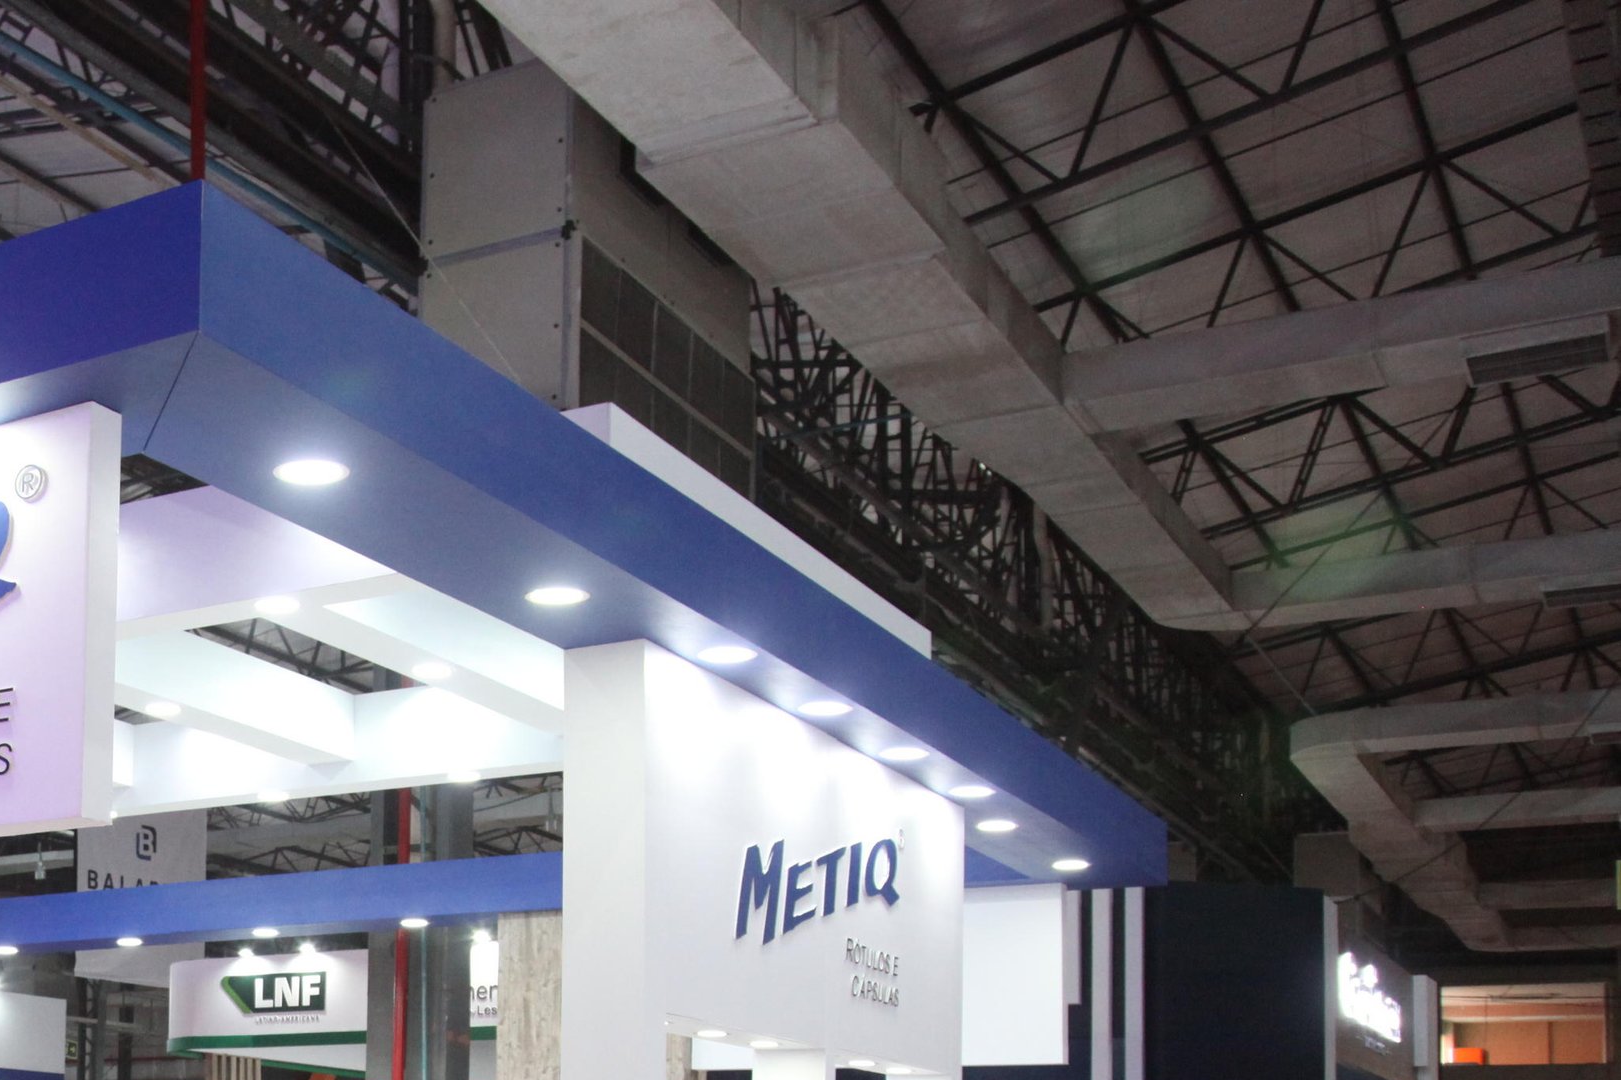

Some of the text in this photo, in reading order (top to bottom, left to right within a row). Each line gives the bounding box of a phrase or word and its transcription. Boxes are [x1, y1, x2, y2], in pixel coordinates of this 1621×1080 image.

[735, 838, 901, 946] METIQ
[845, 937, 900, 977] RÓTULOS E
[254, 974, 321, 1009] LNF
[850, 974, 900, 1008] CÁPSULAS
